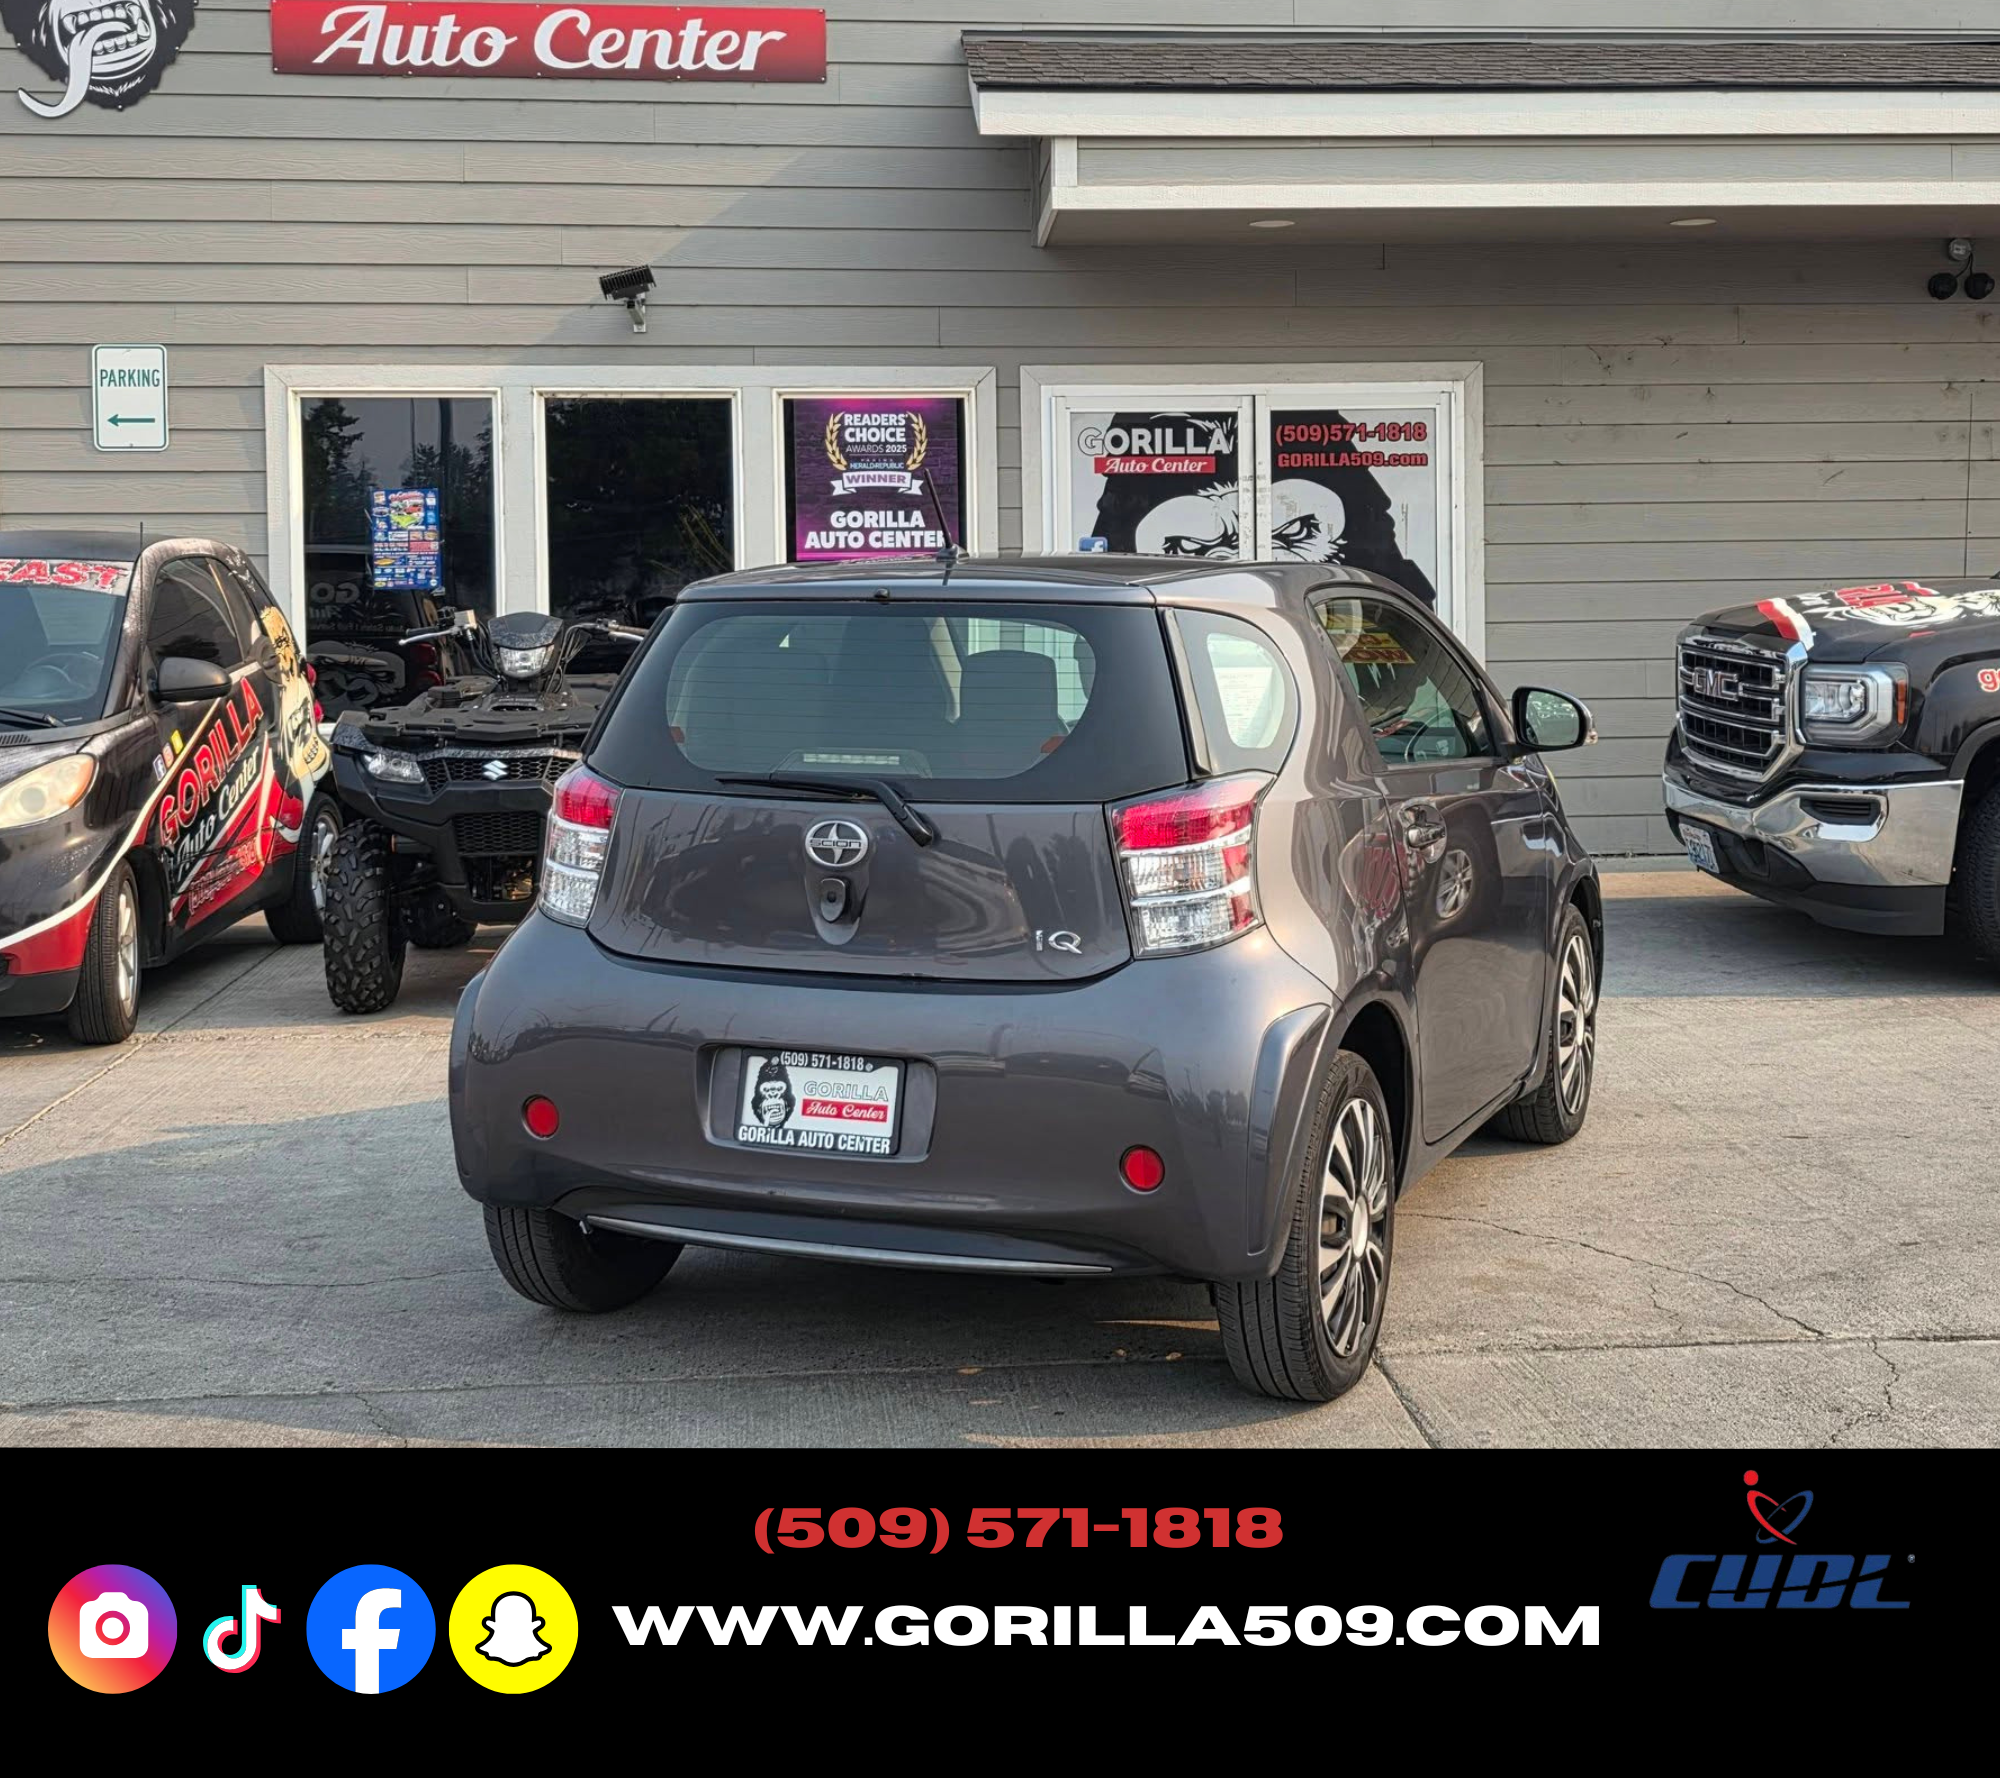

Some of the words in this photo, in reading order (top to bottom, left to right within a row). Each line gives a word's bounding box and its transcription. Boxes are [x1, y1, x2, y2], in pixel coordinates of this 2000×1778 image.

[312, 4, 517, 67] Auto
[534, 8, 786, 71] Center
[100, 368, 161, 387] PARKING
[844, 428, 906, 443] CHOICE
[1078, 426, 1234, 456] GORILLA
[1275, 421, 1428, 447] (509)571-1818
[845, 444, 884, 453] AWARDS
[885, 444, 907, 453] 2025
[1104, 457, 1147, 474] Auto
[1152, 457, 1208, 473] Center
[1277, 452, 1429, 468] GORILLA509.com
[846, 474, 907, 484] WINNER
[830, 510, 925, 528] GORILLA
[805, 531, 866, 549] AUTO
[1693, 667, 1739, 701] GMC
[160, 677, 264, 845] GORILLA
[218, 745, 259, 820] Center
[780, 1051, 809, 1066] (509)
[811, 1053, 864, 1071] 571-1818
[803, 1080, 889, 1102] GORILLA
[805, 1102, 838, 1116] Auto
[842, 1104, 886, 1120] Center
[798, 1130, 835, 1150] AUTO
[838, 1133, 891, 1155] CENTER
